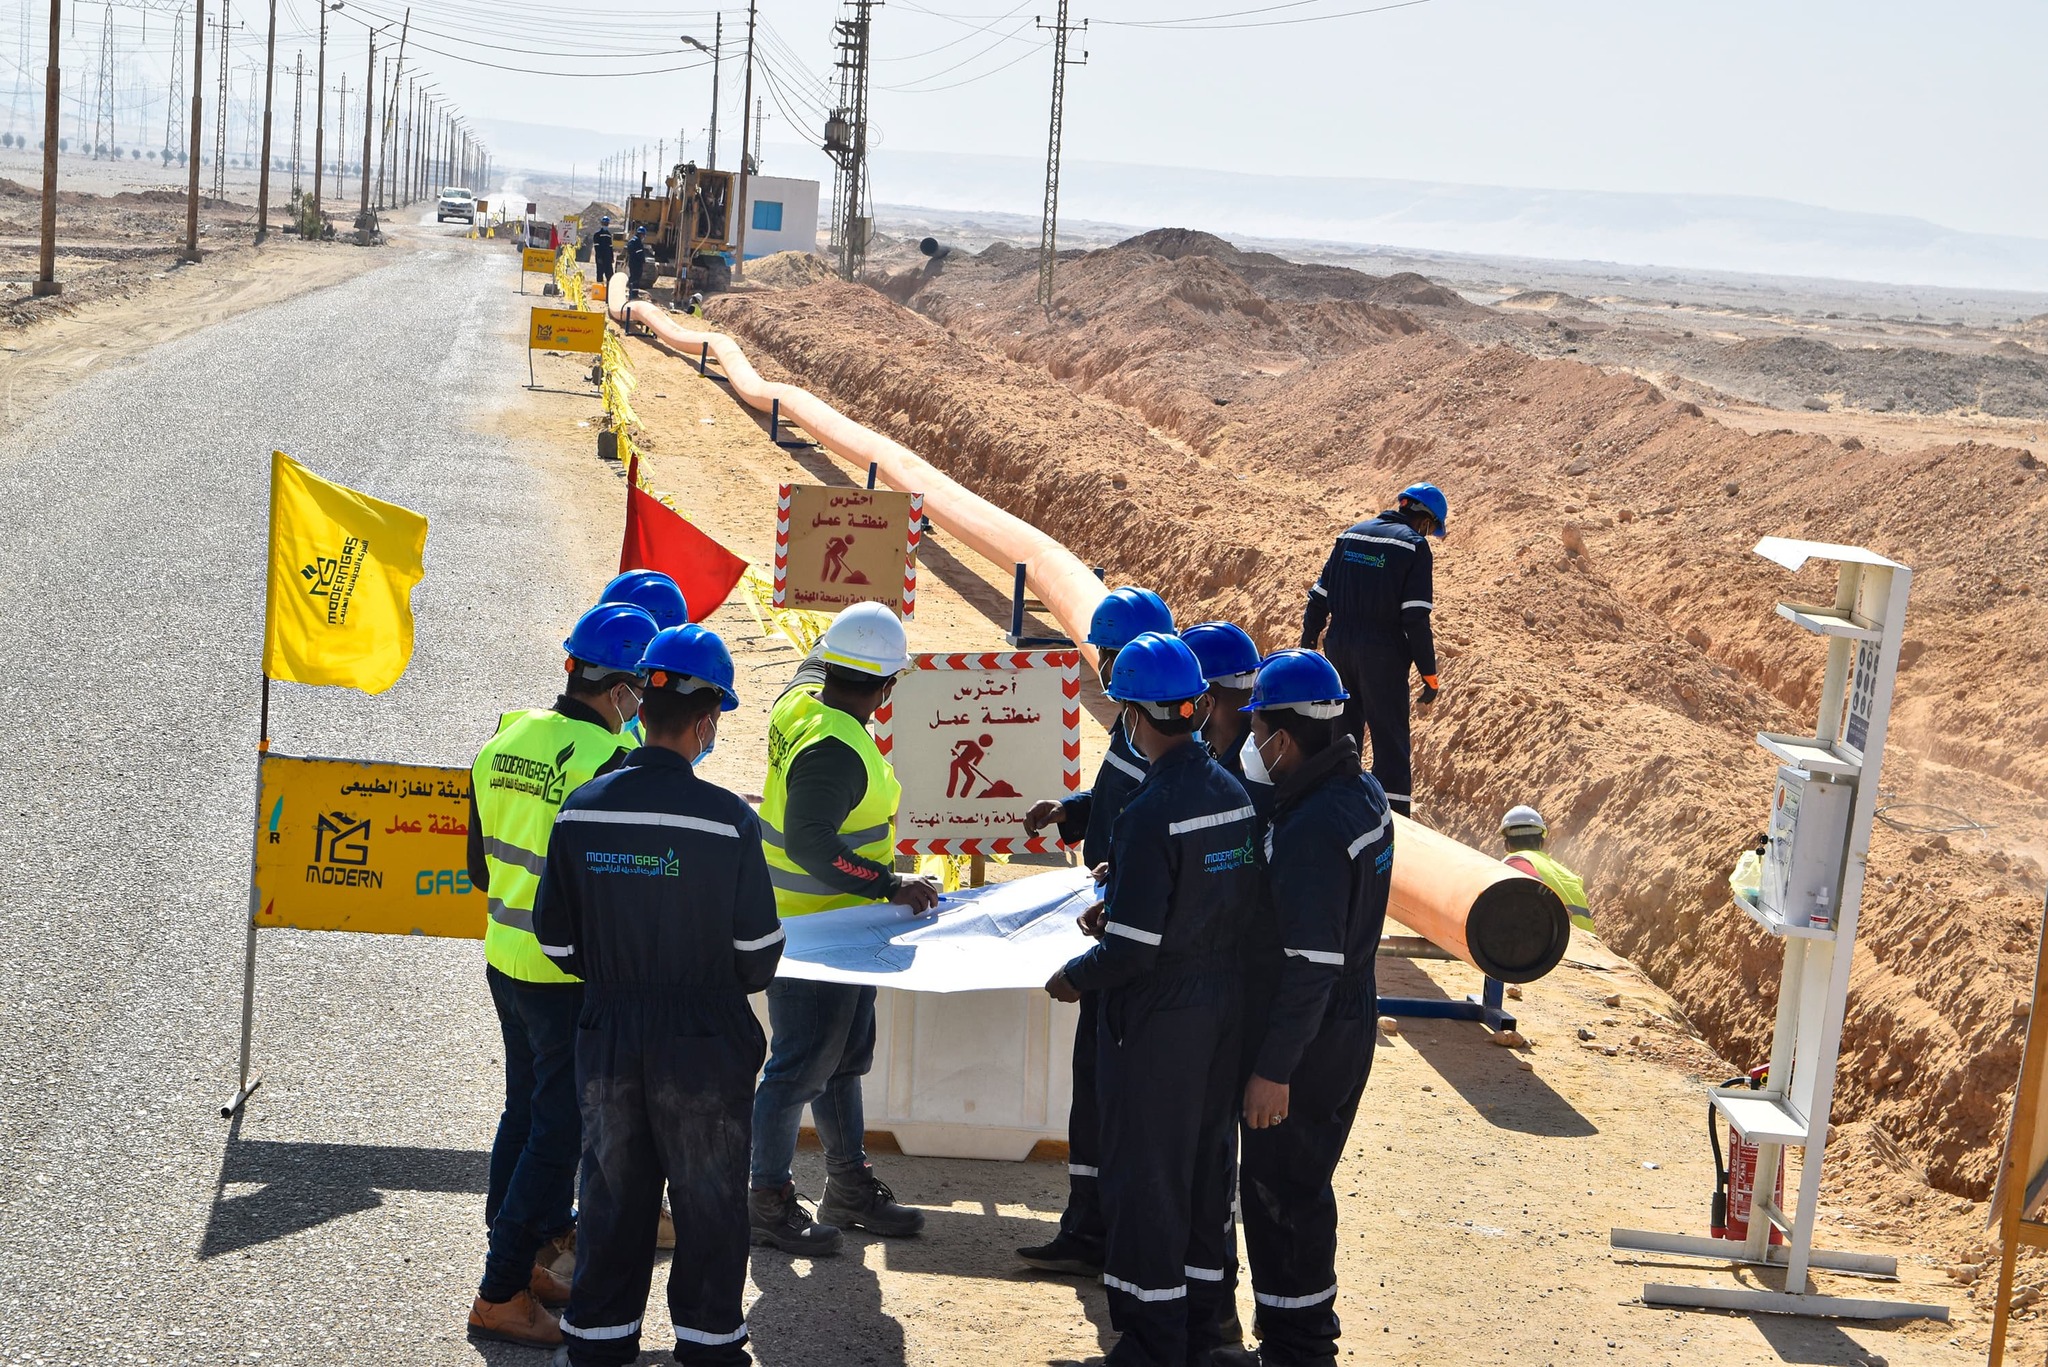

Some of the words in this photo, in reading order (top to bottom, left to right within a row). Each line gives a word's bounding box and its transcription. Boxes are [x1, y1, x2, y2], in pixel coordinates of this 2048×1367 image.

[829, 493, 873, 508] احترس
[812, 512, 841, 528] عمل
[848, 513, 889, 530] منطقة
[327, 536, 359, 625] MODERNGAS
[929, 709, 971, 730] عمل
[981, 706, 1041, 725] منطقة
[491, 753, 550, 782] MODERNGAS
[398, 779, 433, 799] للغاز
[437, 780, 471, 805] ديثة
[385, 814, 422, 835] عمل
[428, 813, 469, 836] طقة
[269, 832, 280, 844] R
[586, 851, 660, 867] MODERNGAS
[305, 864, 384, 890] MODERN
[416, 869, 473, 896] GAS
